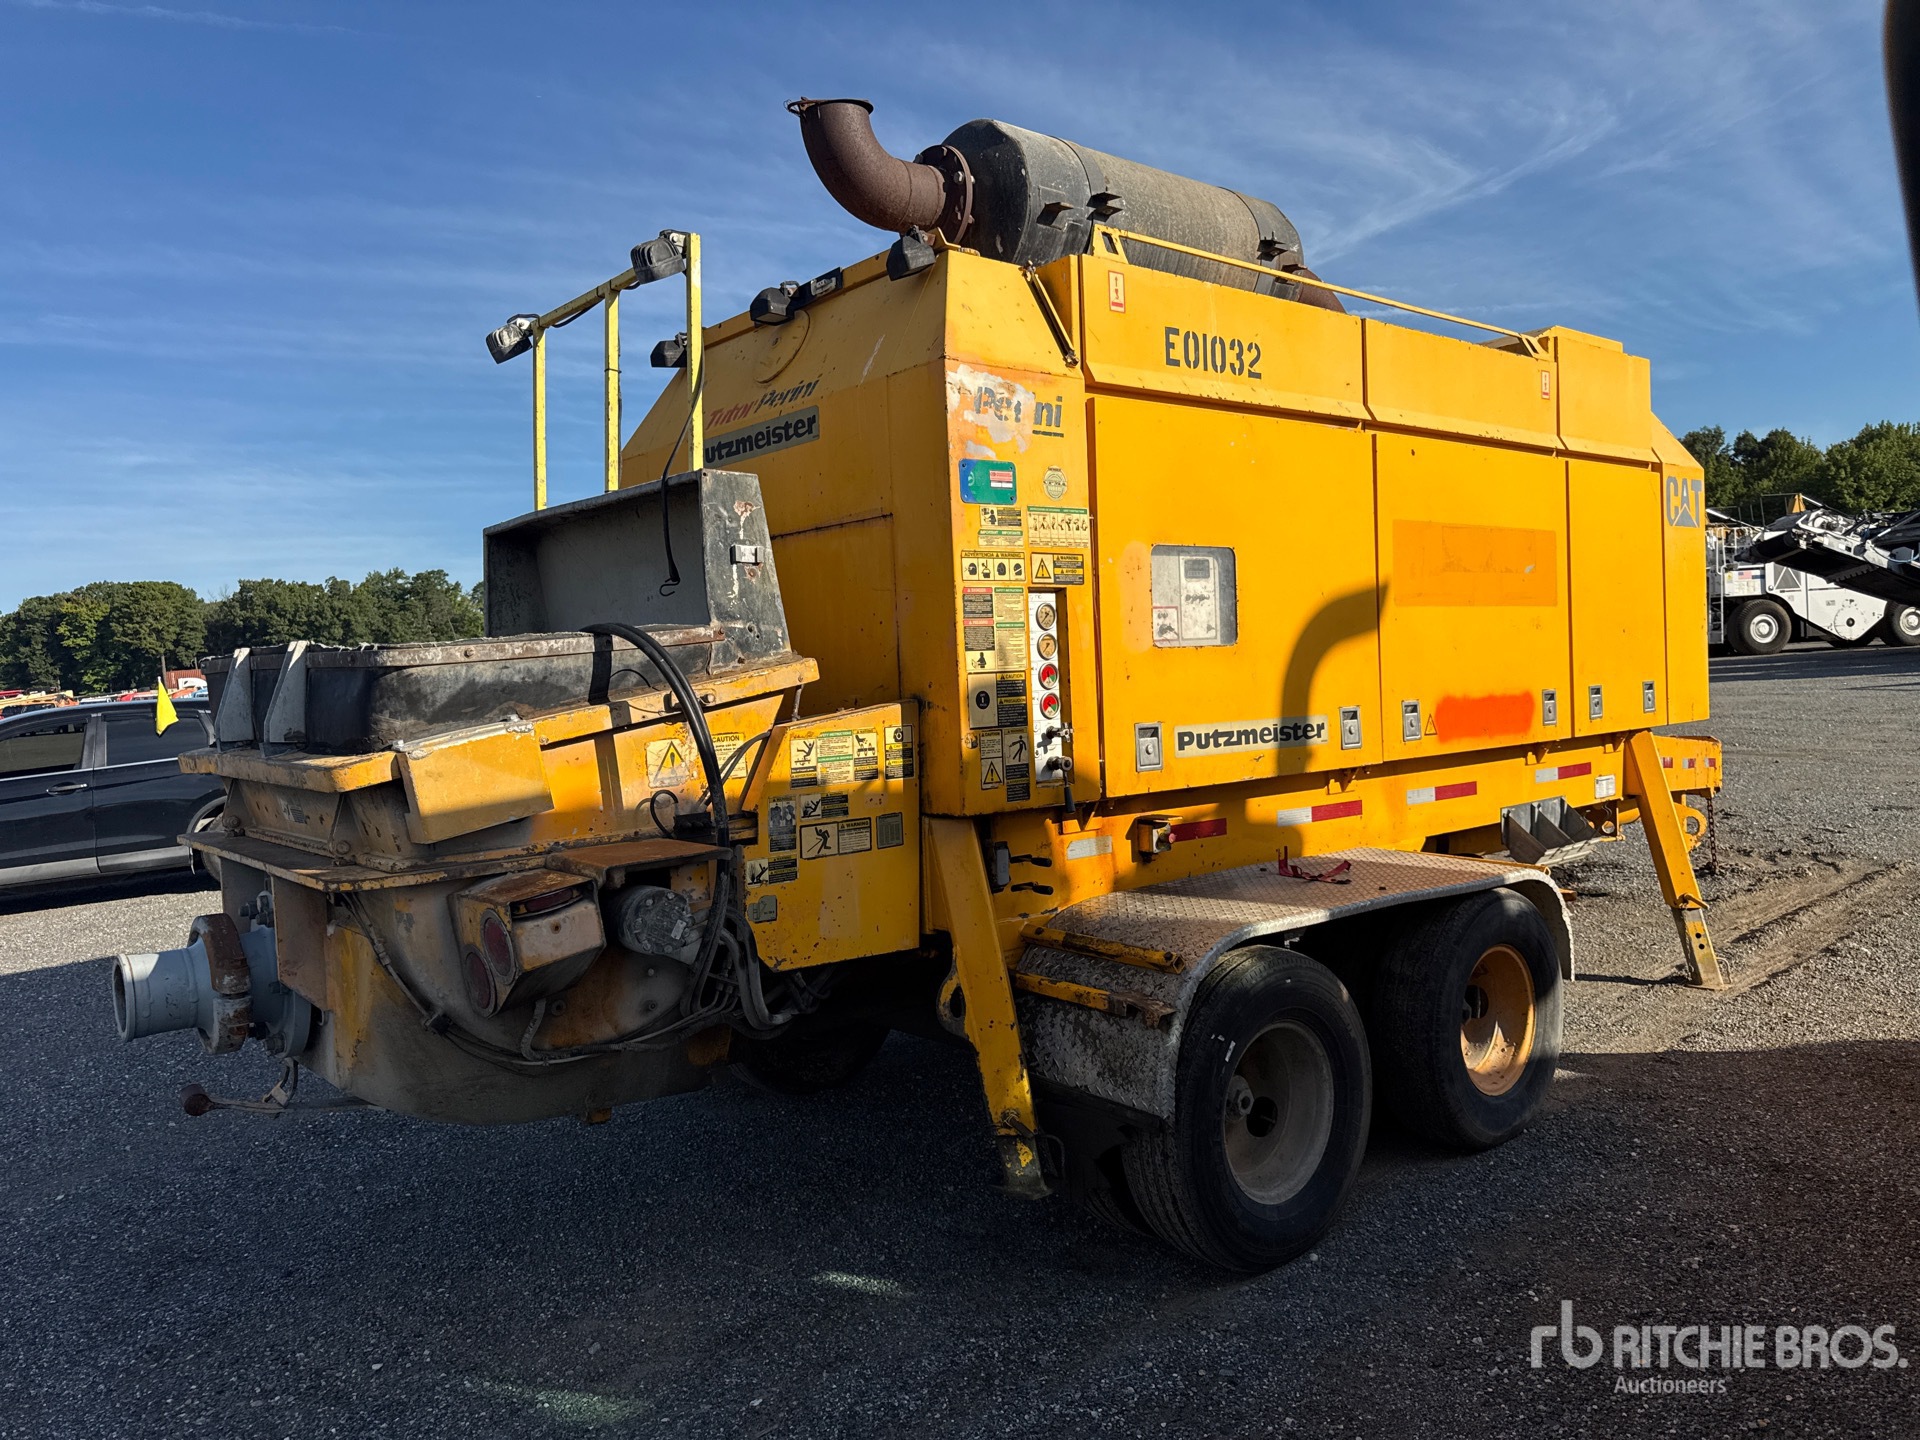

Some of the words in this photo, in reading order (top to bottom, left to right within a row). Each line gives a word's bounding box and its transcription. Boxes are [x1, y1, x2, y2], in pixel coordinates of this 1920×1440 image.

[1164, 326, 1262, 380] E01032
[704, 414, 817, 464] utzmeister
[1665, 475, 1703, 528] CAT
[1176, 721, 1326, 752] Putzmeister
[845, 820, 869, 828] WARNING
